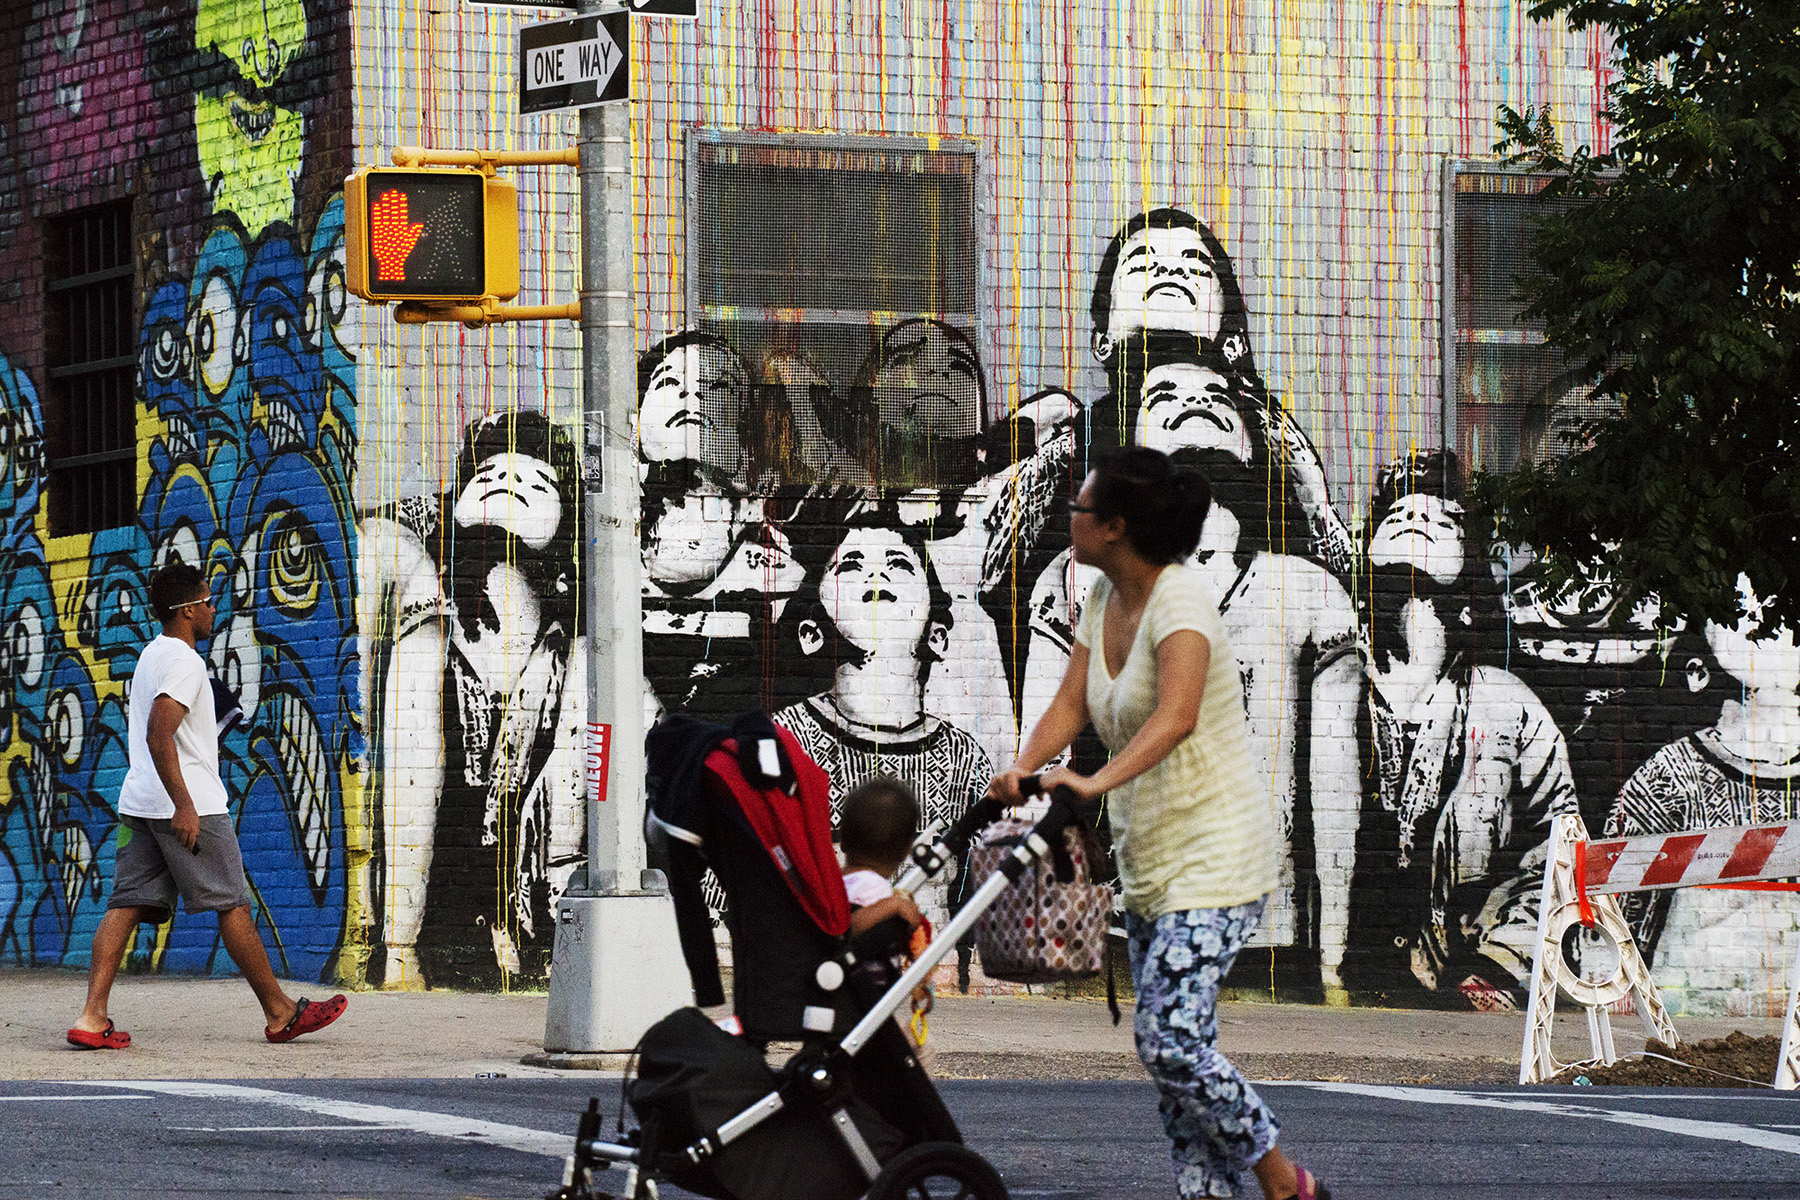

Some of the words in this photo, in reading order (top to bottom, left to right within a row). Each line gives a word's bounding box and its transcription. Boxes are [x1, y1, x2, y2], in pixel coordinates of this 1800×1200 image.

[534, 49, 565, 85] ONE
[578, 41, 612, 78] WAY
[587, 725, 604, 801] MEOW!
